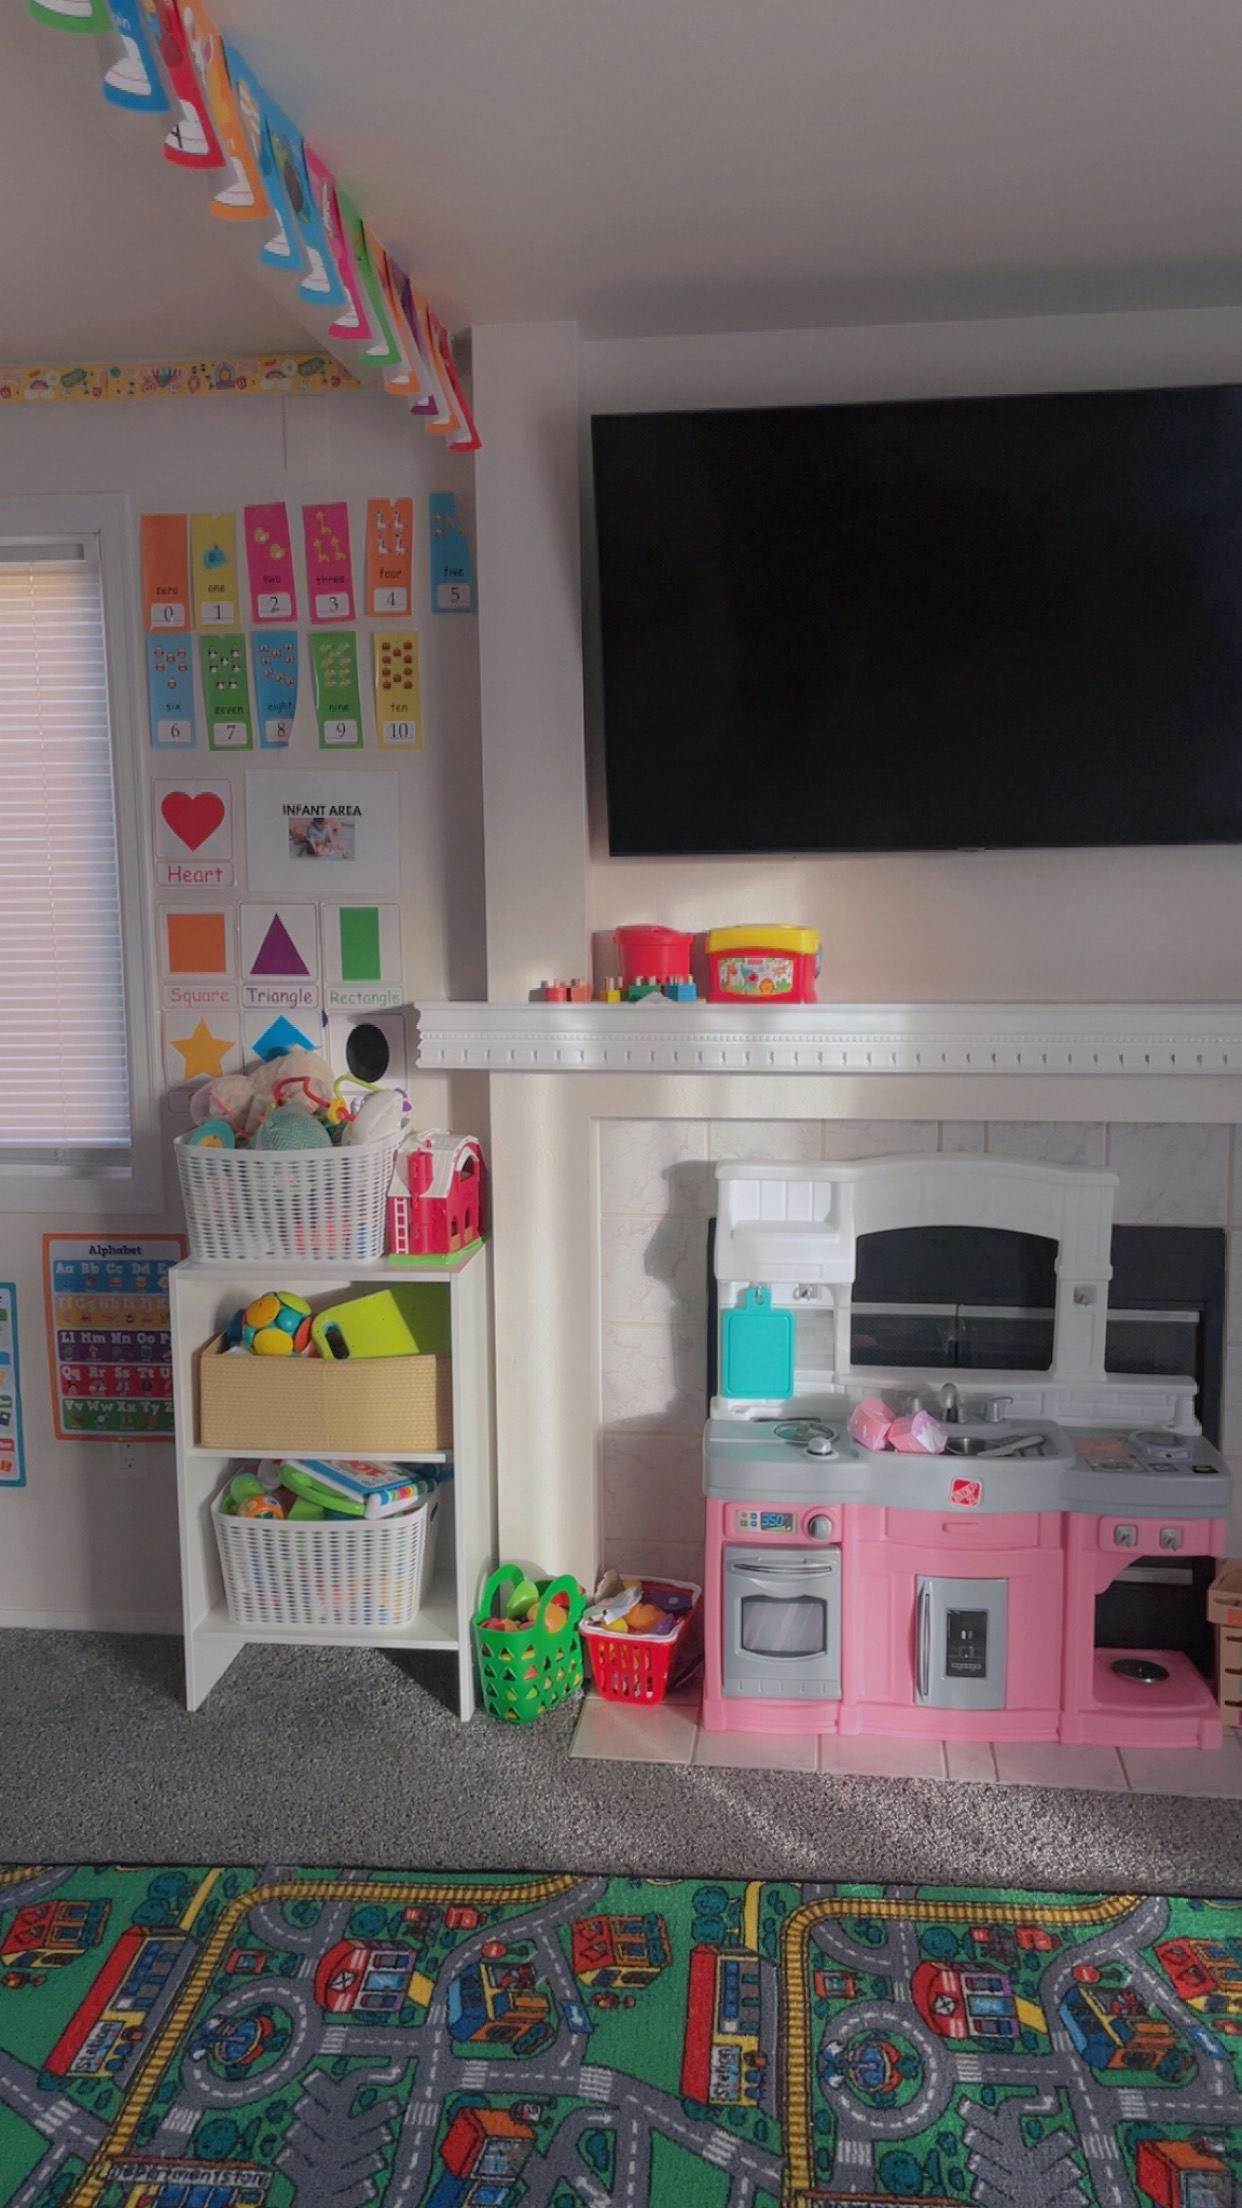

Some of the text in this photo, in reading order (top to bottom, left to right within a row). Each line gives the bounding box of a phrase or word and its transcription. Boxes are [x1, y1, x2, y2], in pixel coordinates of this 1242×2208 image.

[379, 568, 402, 580] four
[386, 589, 397, 606] 4
[450, 587, 460, 602] 5
[270, 596, 280, 613] 2
[329, 596, 339, 612] 3
[163, 606, 174, 622] 0
[170, 723, 181, 738] 6
[226, 724, 237, 741] 7
[277, 722, 286, 738] 8
[336, 722, 346, 738] 9
[391, 723, 409, 738] 10
[282, 804, 362, 817] INFANT AREA
[167, 865, 223, 883] Heart
[171, 988, 229, 1005] Square
[248, 987, 312, 1008] Triangle
[329, 990, 400, 1007] Rectangle
[89, 1245, 142, 1258] Alphabet
[56, 1263, 75, 1274] Aa
[81, 1263, 100, 1274] Bb
[105, 1263, 123, 1274] Cc
[132, 1263, 151, 1274] Dd
[81, 1332, 106, 1344] Mm
[111, 1332, 131, 1344] Nn
[62, 1366, 81, 1380] Qq
[64, 1400, 84, 1411] Vv
[87, 1400, 113, 1411] Ww
